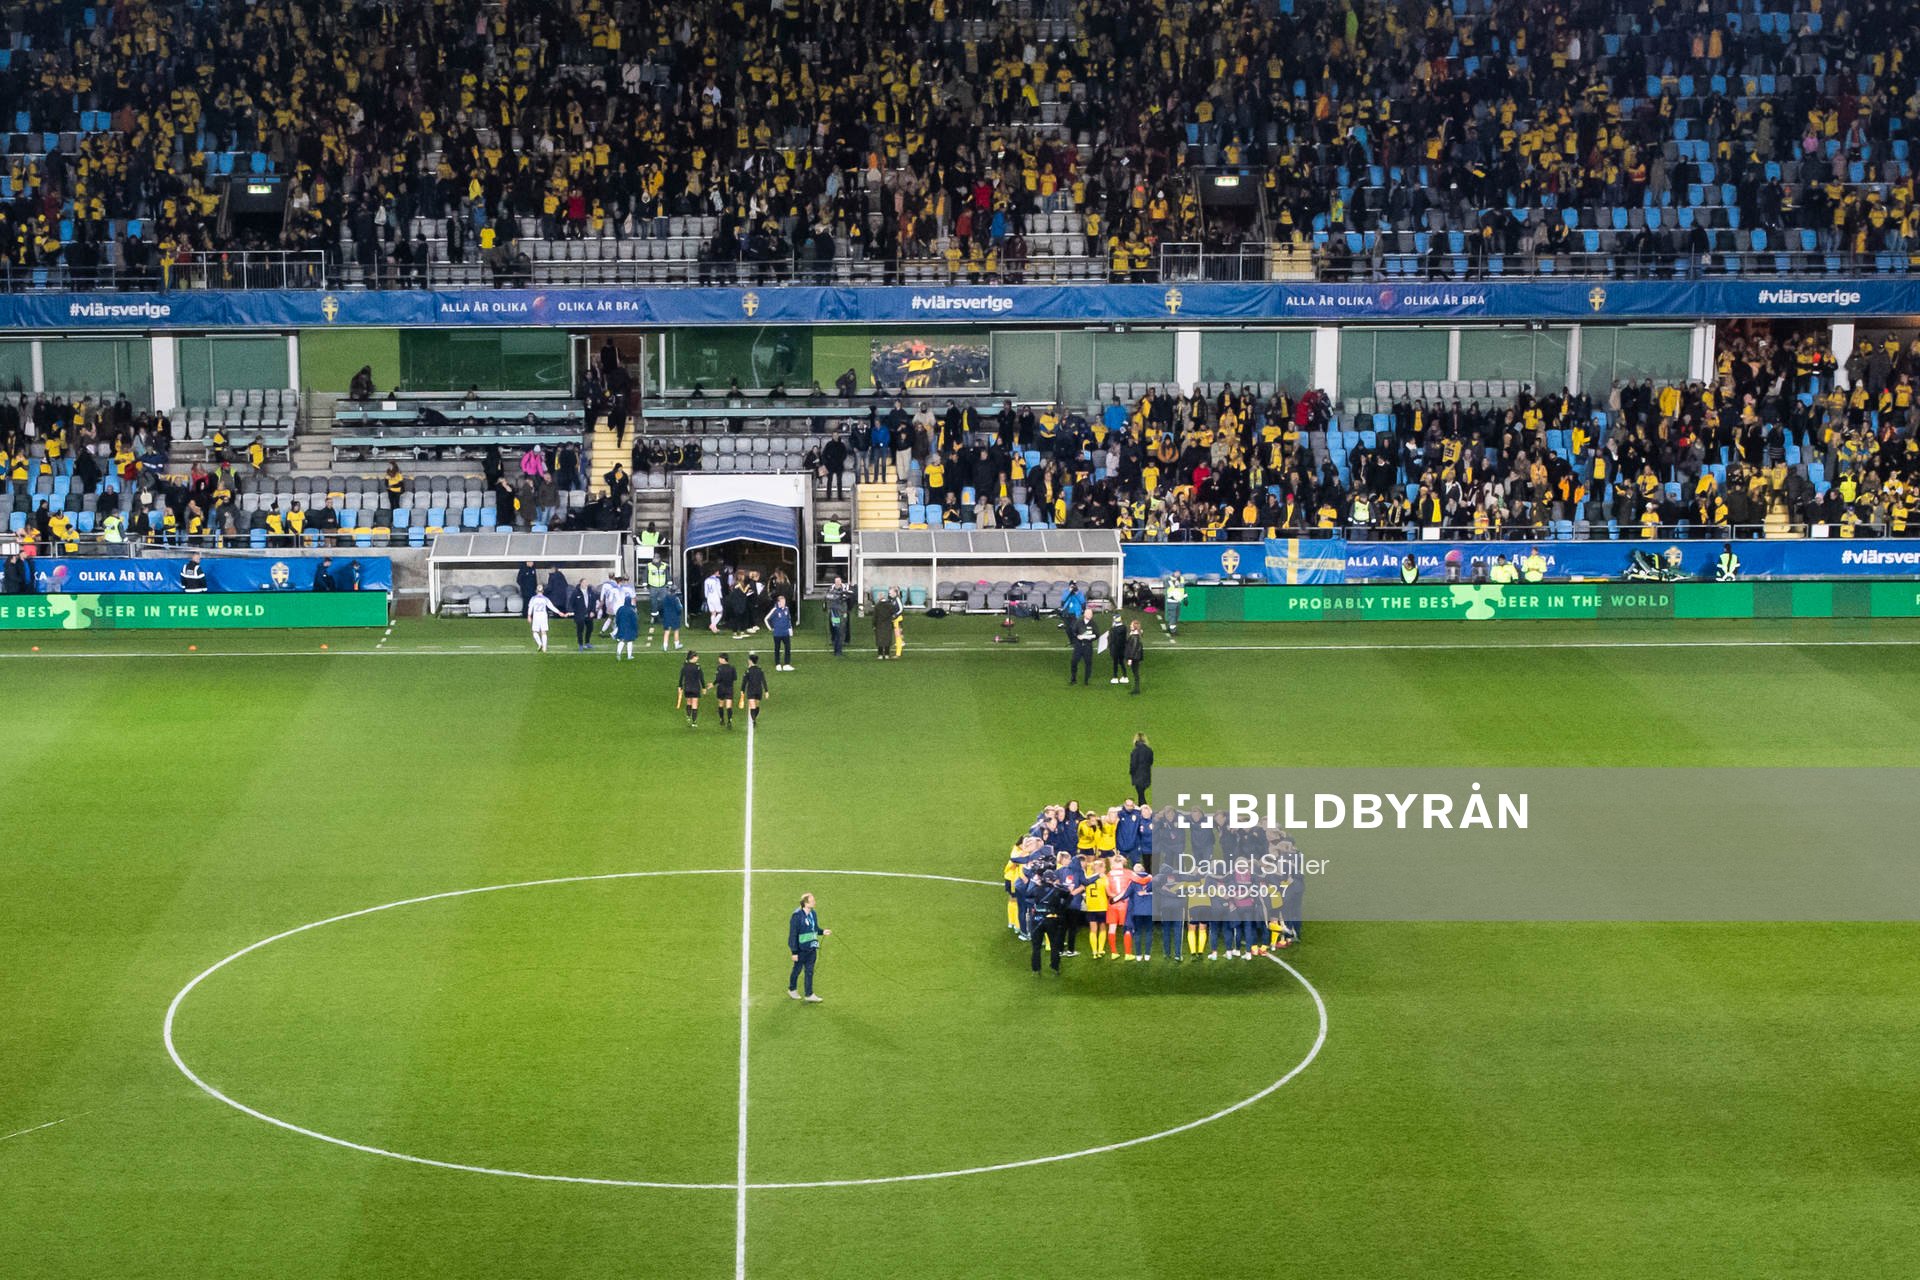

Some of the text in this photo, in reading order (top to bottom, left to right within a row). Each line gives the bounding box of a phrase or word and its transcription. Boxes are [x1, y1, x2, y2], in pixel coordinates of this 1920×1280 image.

[912, 295, 1013, 312] #viärsverige
[1286, 294, 1373, 306] ALLA ÄR OLIKA
[1404, 294, 1485, 306] OLIKA ÄR BRA
[1758, 289, 1861, 306] #viärsverige
[70, 302, 170, 319] #viärsverige
[441, 300, 527, 313] ALLA ÄR OLIKA
[558, 299, 638, 312] OLIKA ÄR BRA
[1347, 556, 1378, 566] ALLA
[1382, 554, 1398, 566] ÄR
[79, 569, 163, 581] OLIKA ÄR BRA
[1289, 595, 1669, 609] PROBABLY THE BEST BEER IN THE WORLD
[17, 607, 55, 618] BEST
[95, 606, 135, 617] BEER
[144, 606, 160, 617] IN
[169, 606, 199, 617] THE
[207, 605, 265, 617] WORLD
